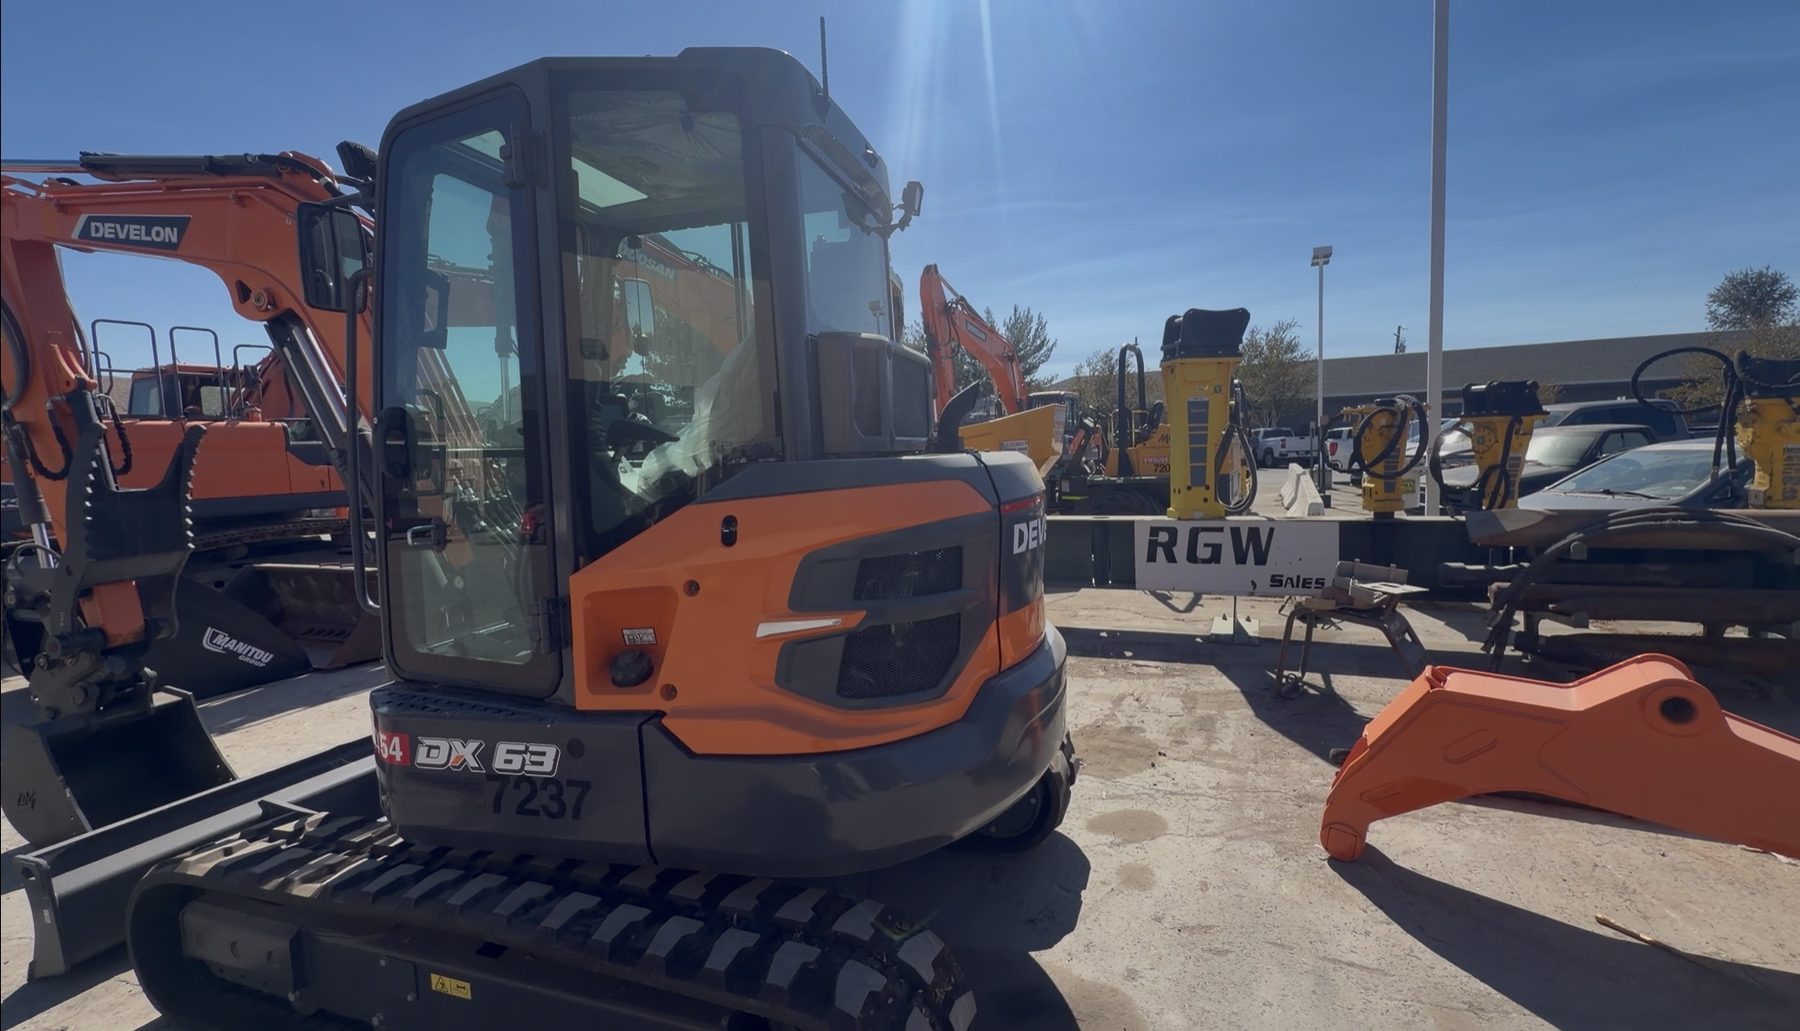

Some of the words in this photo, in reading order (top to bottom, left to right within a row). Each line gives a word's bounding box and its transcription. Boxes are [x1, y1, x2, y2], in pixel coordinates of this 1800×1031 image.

[90, 221, 178, 244] DEVELON
[1146, 526, 1275, 566] RGW
[212, 633, 275, 664] MANITOU
[238, 655, 267, 668] GROUP
[414, 736, 486, 773] DX
[491, 741, 561, 779] 63
[486, 775, 592, 820] 7237
